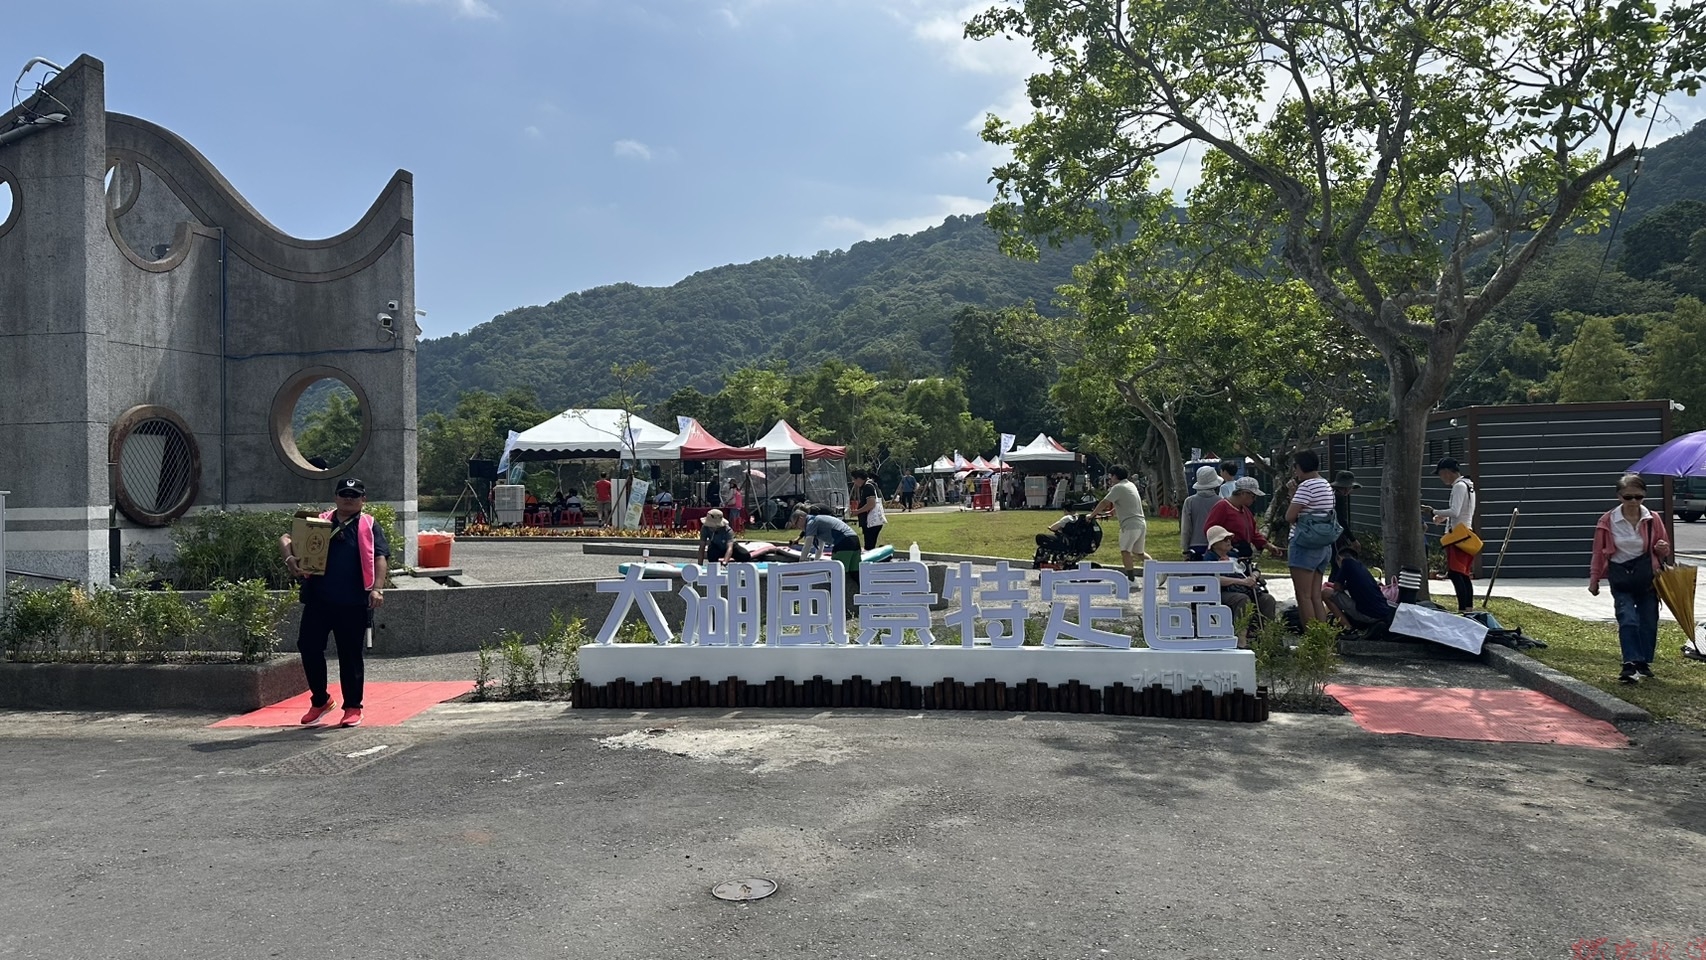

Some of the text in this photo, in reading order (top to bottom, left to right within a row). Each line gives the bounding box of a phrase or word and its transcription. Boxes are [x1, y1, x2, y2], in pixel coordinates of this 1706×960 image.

[595, 561, 1238, 649] 大湖風景特定區
